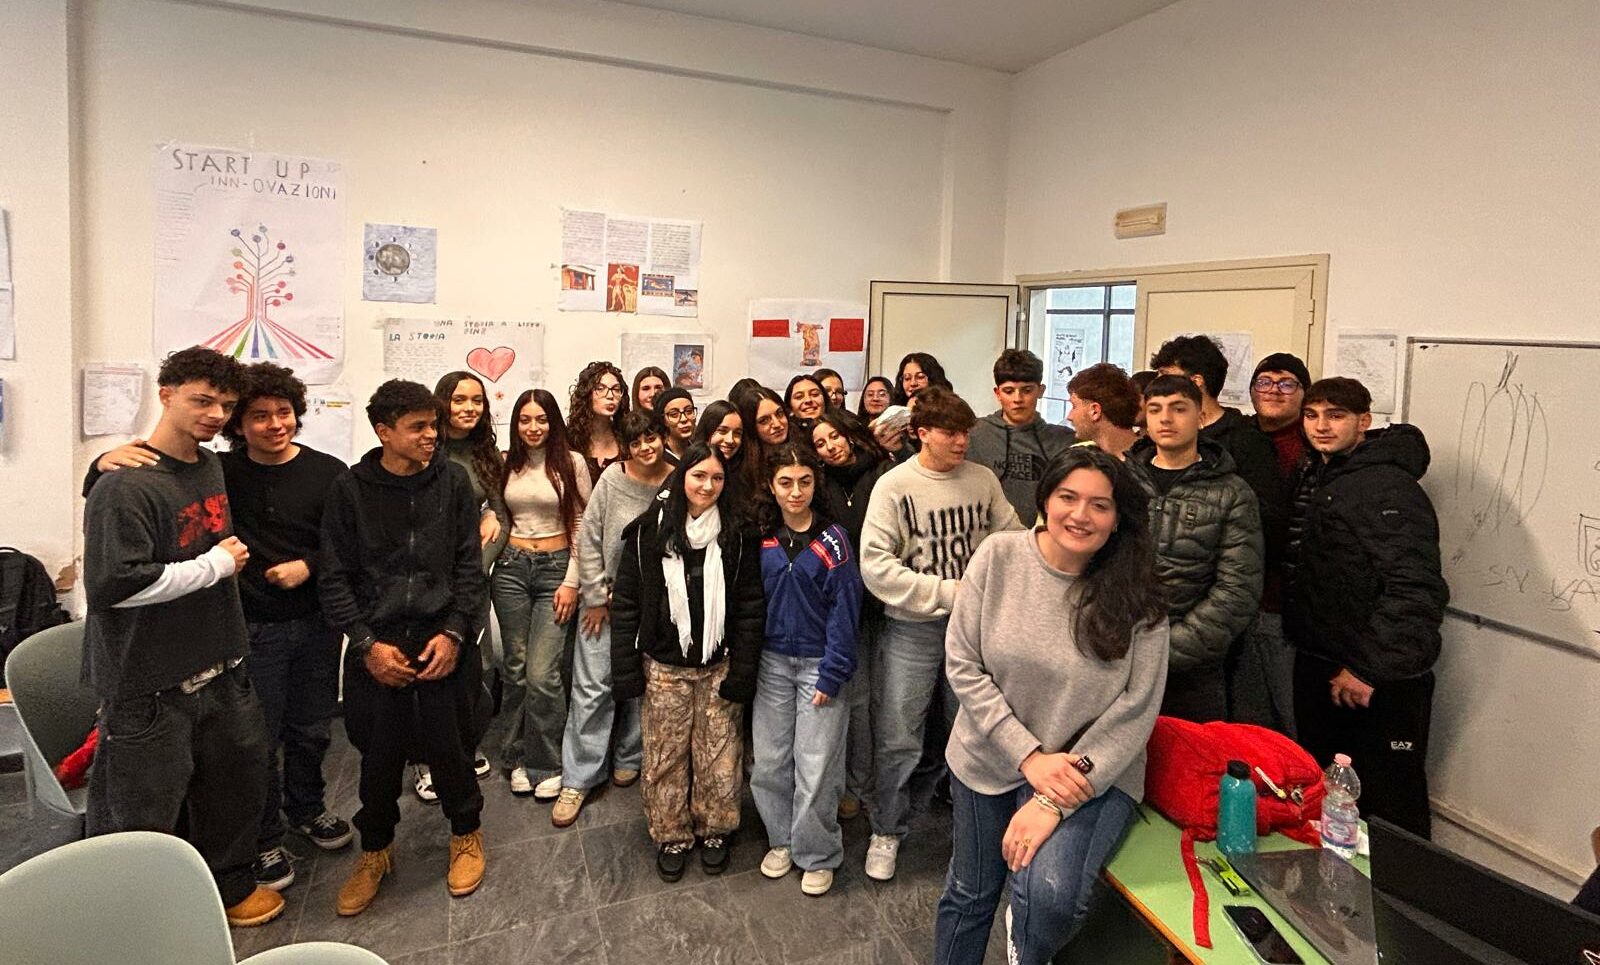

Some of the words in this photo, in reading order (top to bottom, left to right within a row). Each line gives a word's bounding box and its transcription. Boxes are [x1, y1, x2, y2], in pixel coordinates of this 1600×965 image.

[172, 149, 250, 175] START
[276, 160, 311, 179] UP
[389, 333, 401, 341] LA
[1390, 740, 1414, 751] EA7
